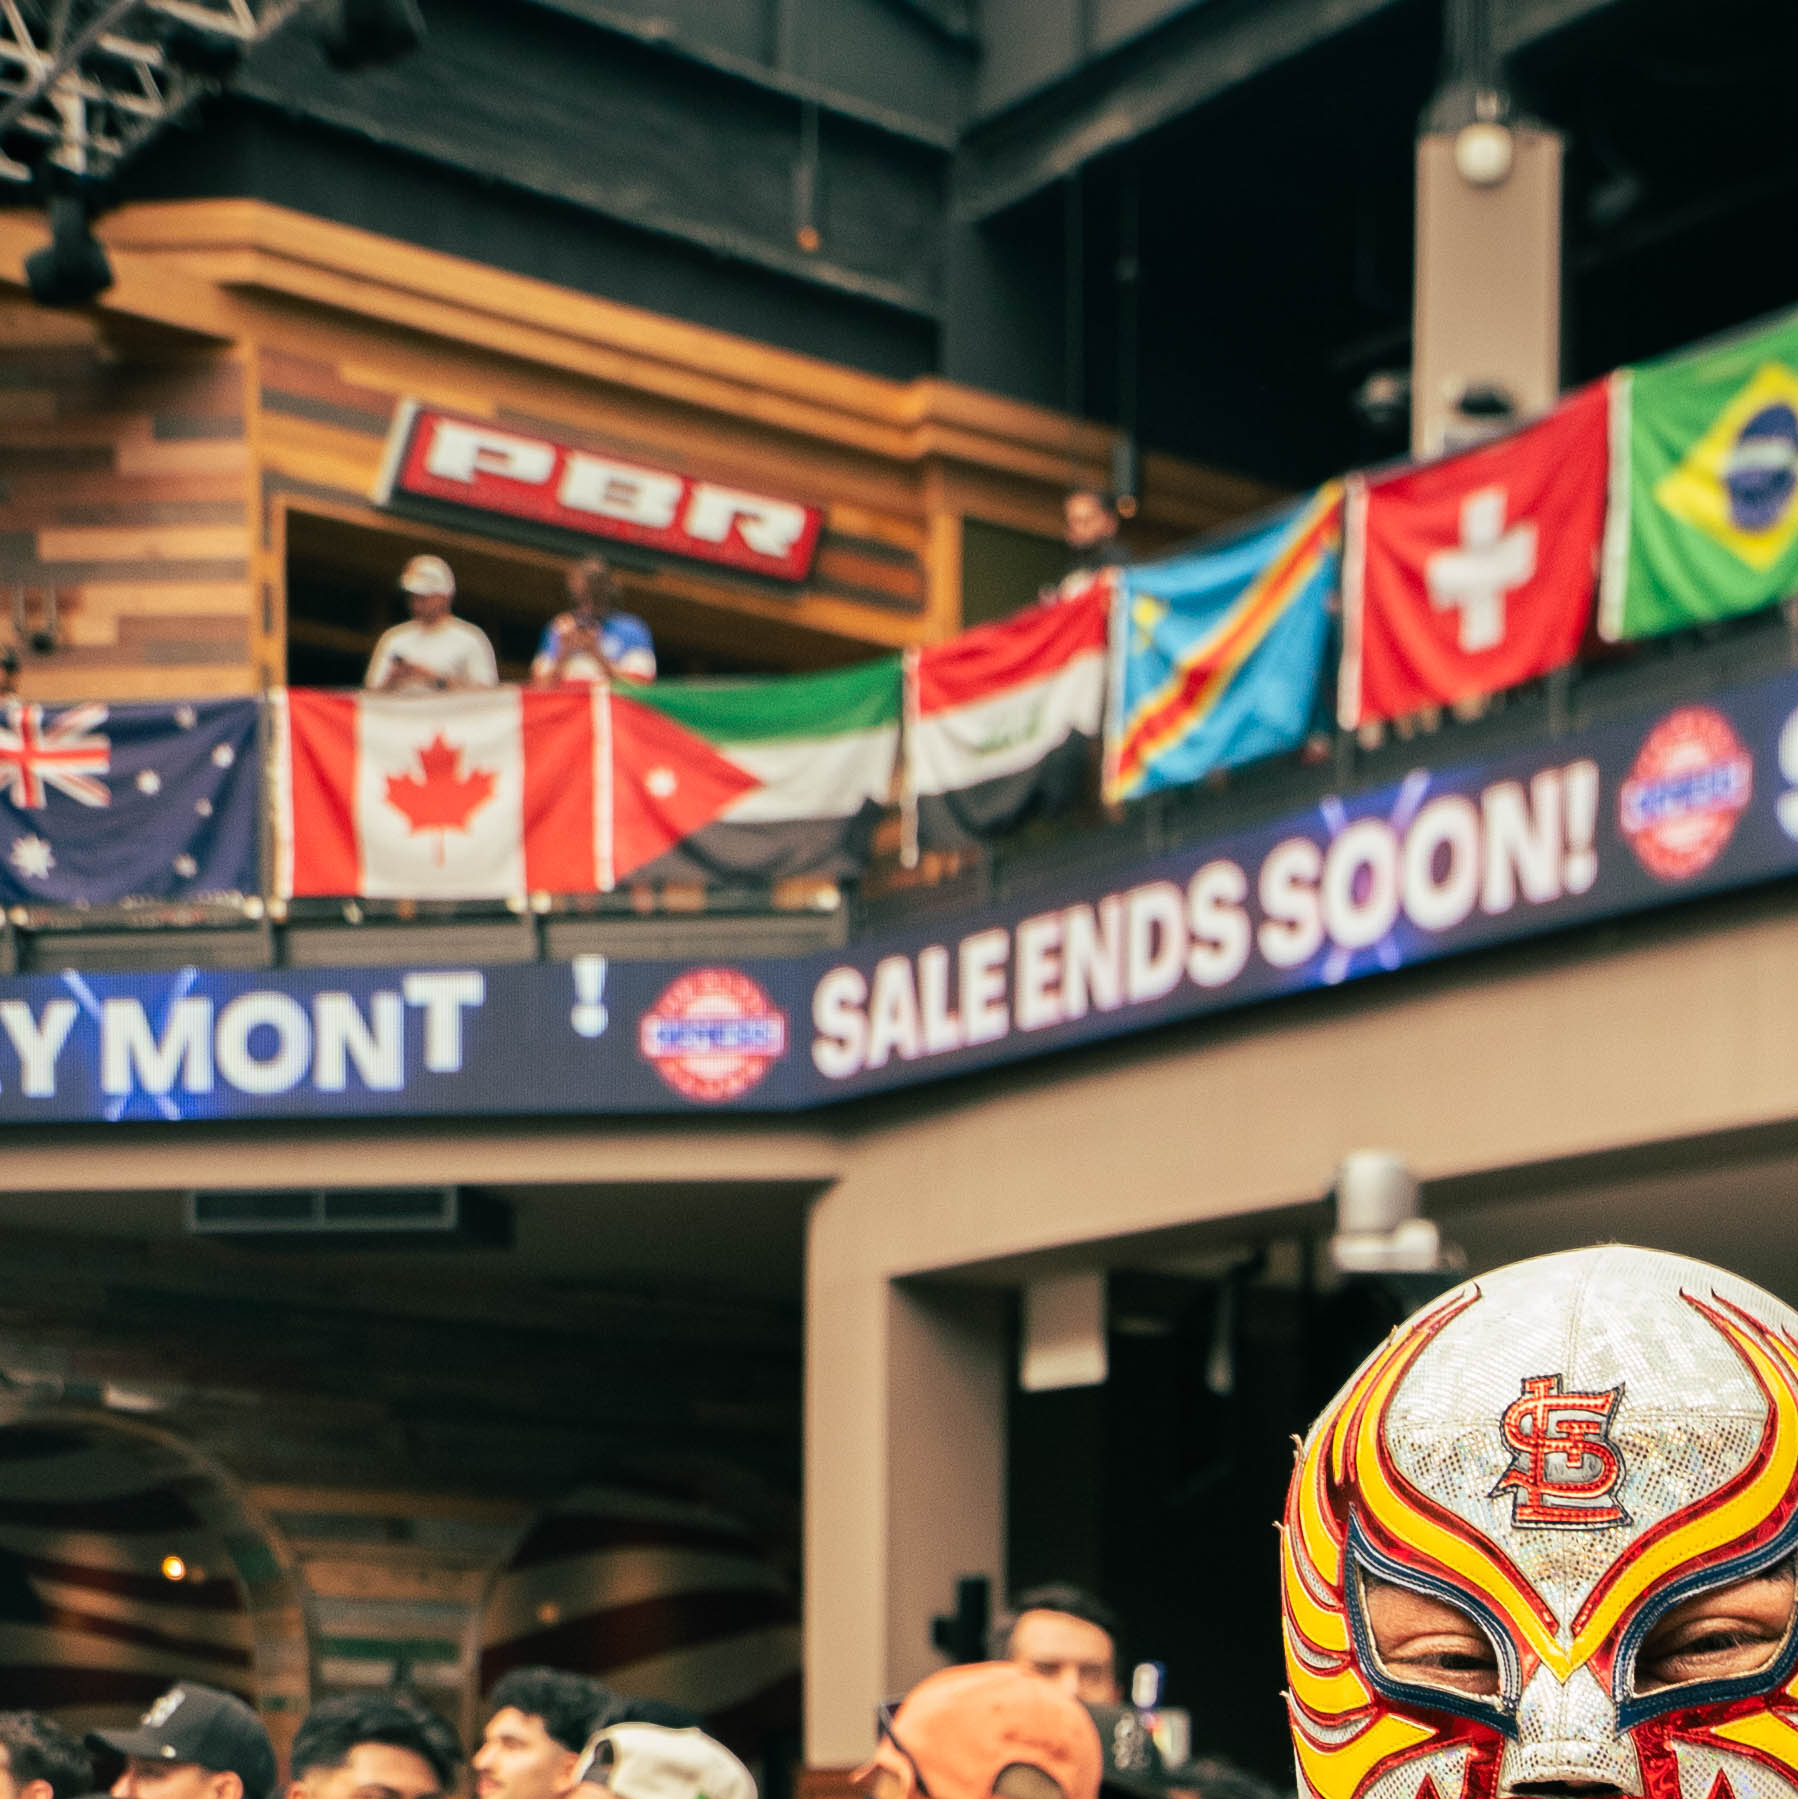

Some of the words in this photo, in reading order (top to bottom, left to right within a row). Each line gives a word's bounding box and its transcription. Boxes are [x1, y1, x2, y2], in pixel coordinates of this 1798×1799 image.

[427, 419, 806, 558] PBR
[812, 929, 1008, 1080] SALE
[1014, 860, 1250, 1032] ENDS
[1258, 760, 1600, 968] SOON!
[0, 998, 80, 1098] Y
[100, 971, 486, 1095] MONT
